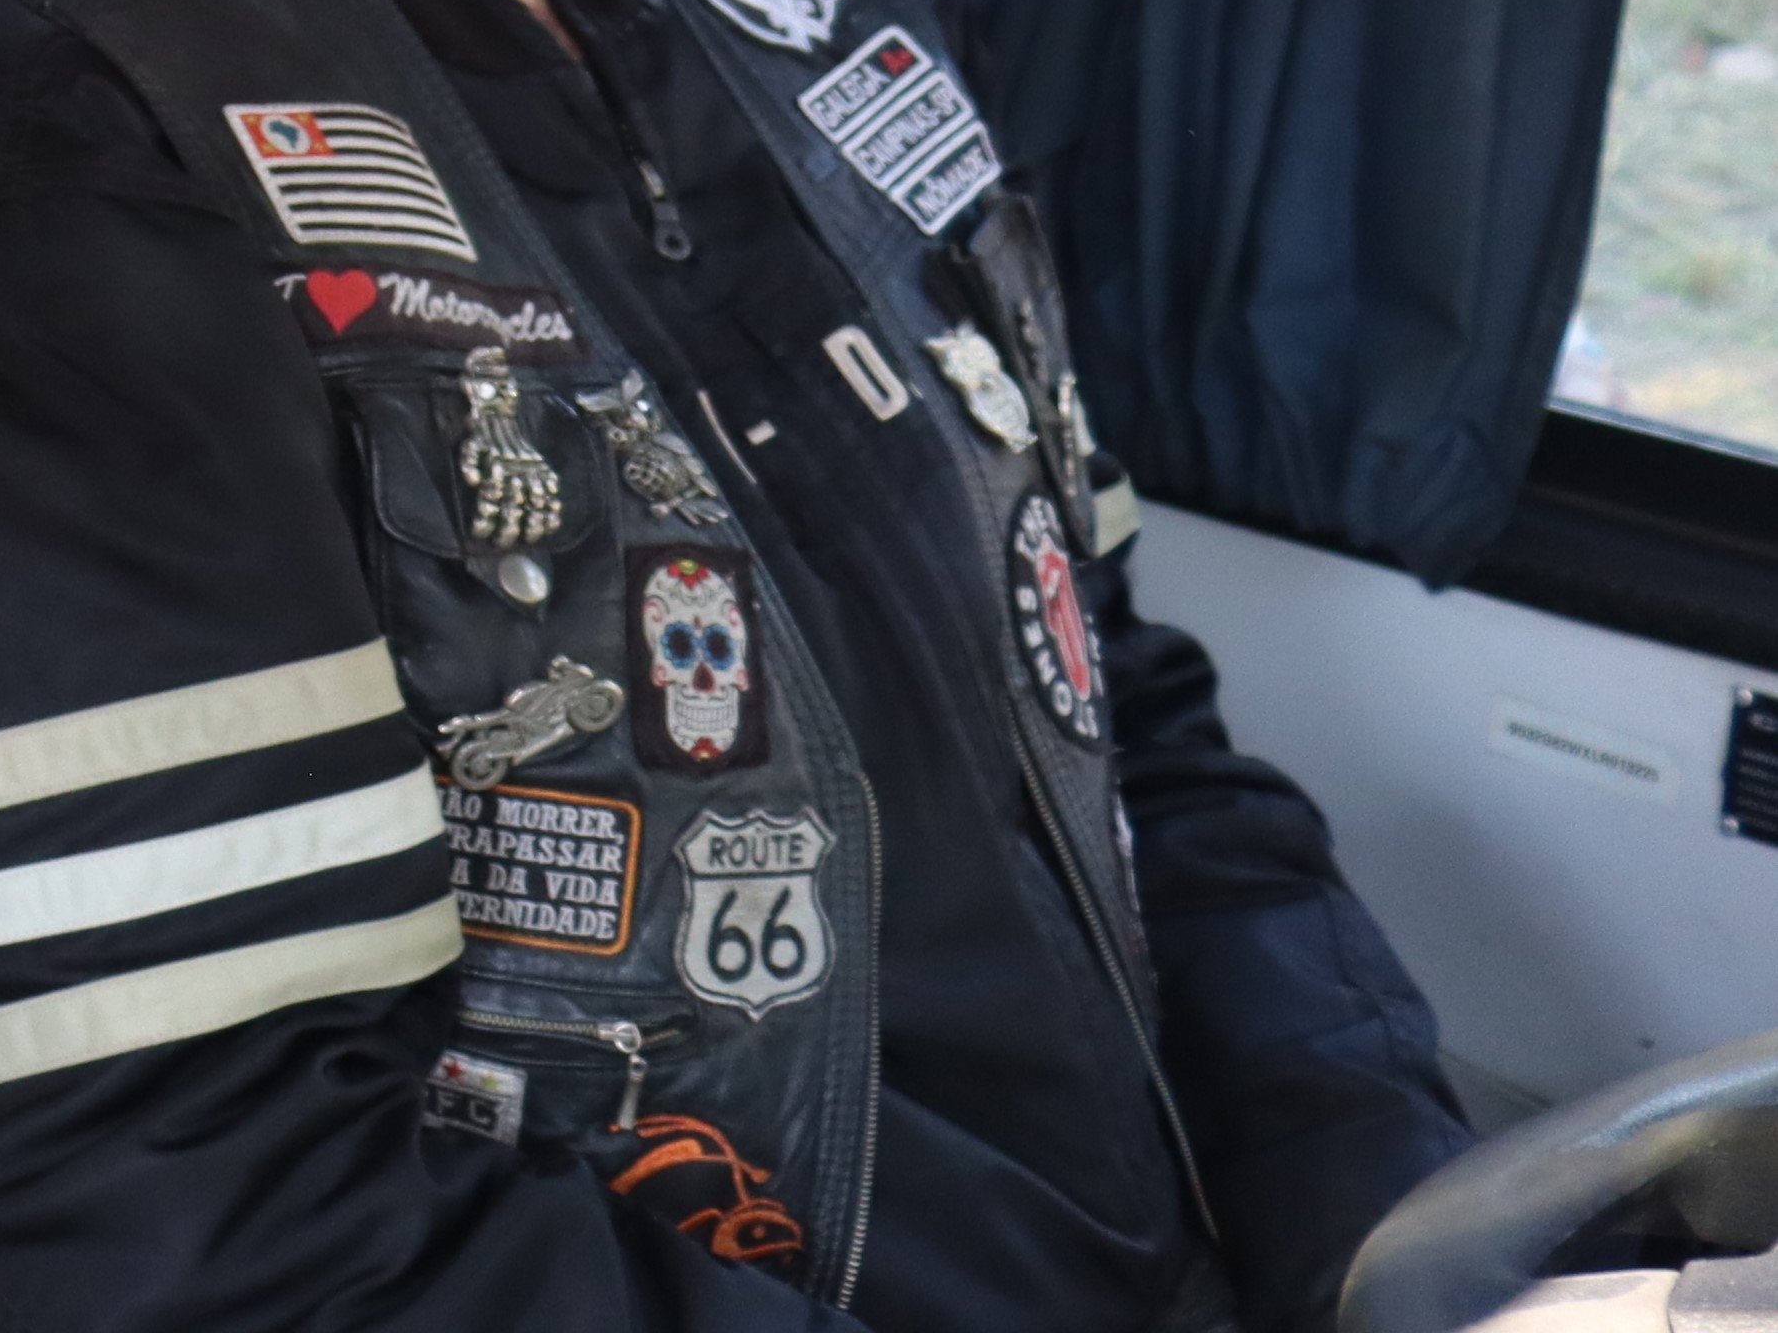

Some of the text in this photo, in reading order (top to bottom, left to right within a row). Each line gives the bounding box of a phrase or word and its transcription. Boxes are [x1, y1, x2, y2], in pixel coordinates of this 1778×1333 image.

[809, 63, 892, 130] GALEGA
[856, 84, 960, 178] CAMPINAS-SP
[495, 796, 625, 845] MORRER,
[709, 834, 806, 869] ROUTE
[487, 862, 528, 896] DA
[545, 871, 620, 908] VIDA
[707, 887, 807, 983] 66
